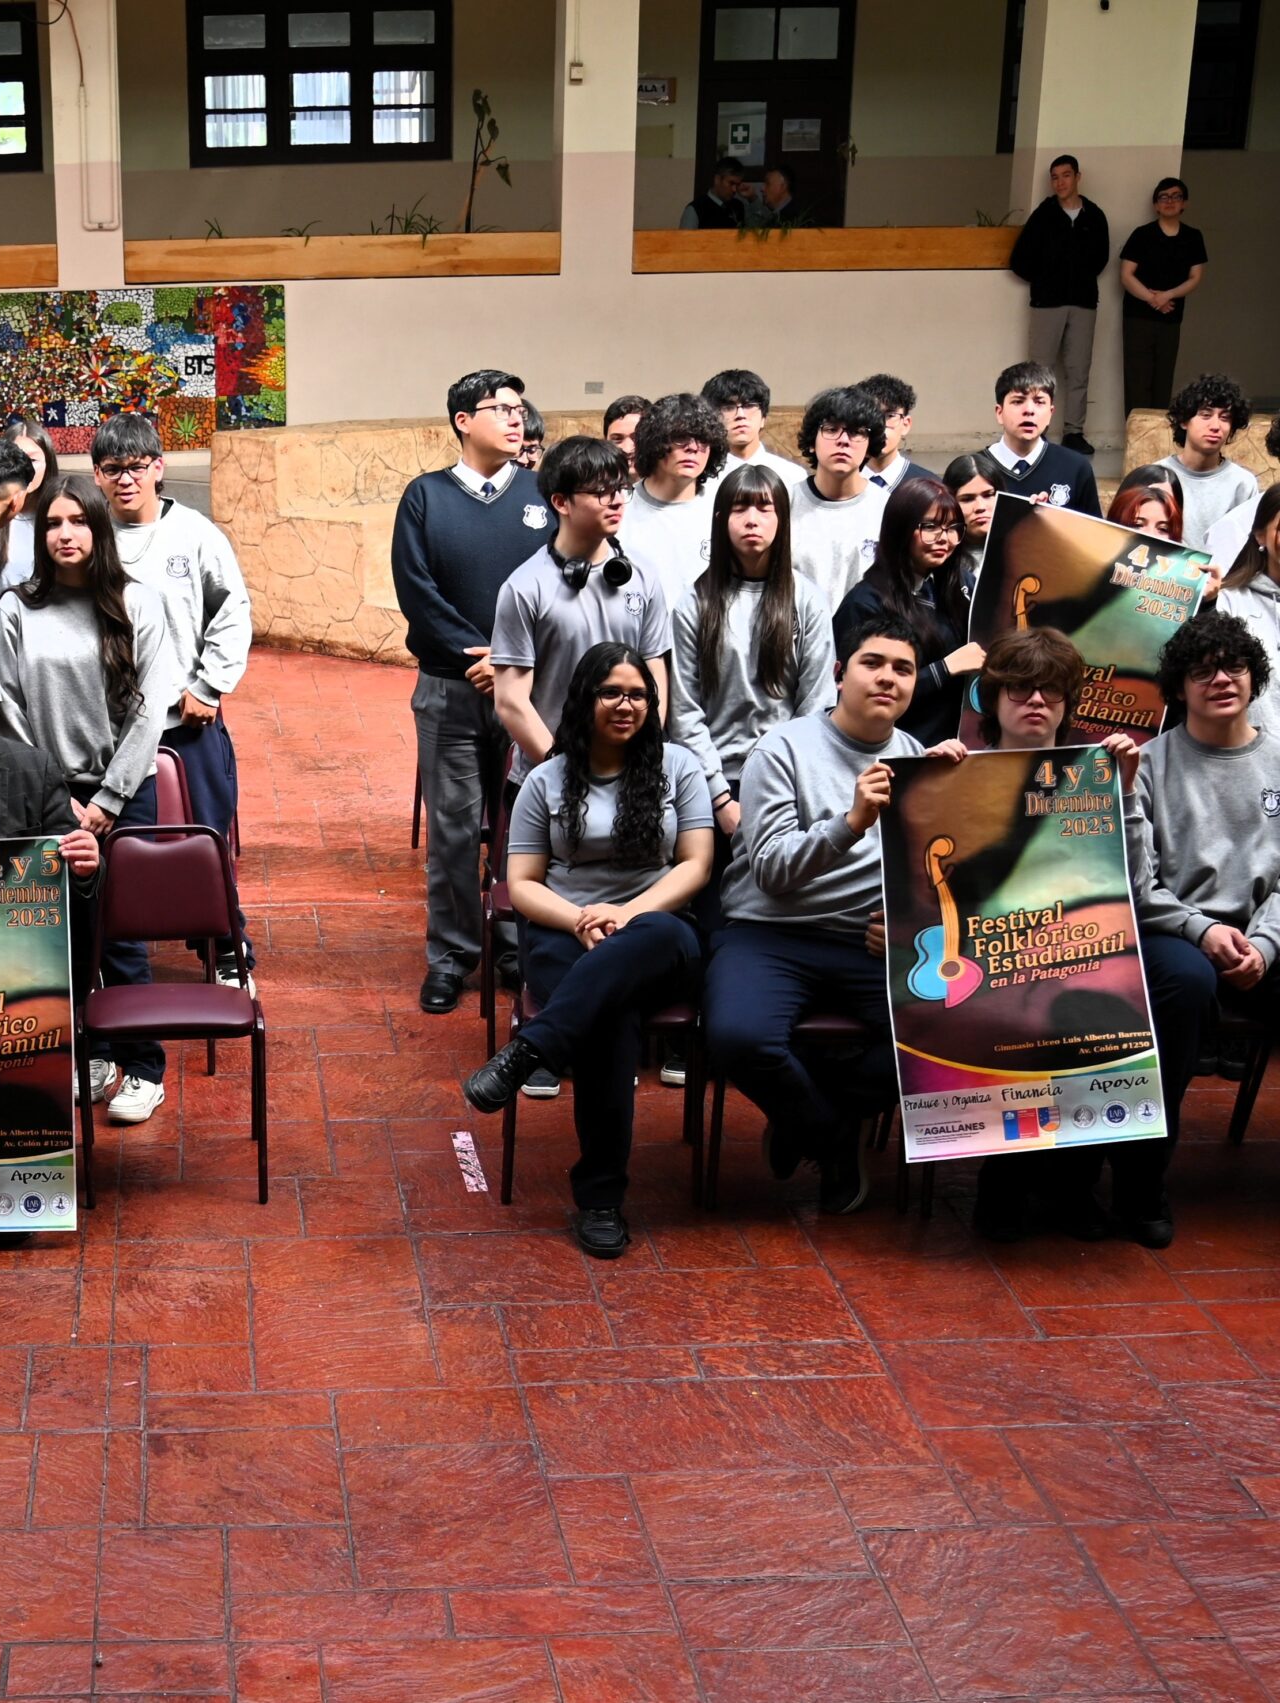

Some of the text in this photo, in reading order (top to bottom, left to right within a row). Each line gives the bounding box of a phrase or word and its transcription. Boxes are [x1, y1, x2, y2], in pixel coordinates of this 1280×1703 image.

[638, 84, 658, 92] ALA
[185, 355, 215, 375] BTS
[1128, 544, 1201, 579] 4 y 5
[1110, 562, 1194, 604] Diciembre
[1135, 596, 1187, 623] 2025
[1082, 682, 1135, 706] órico
[1035, 758, 1112, 792] 4 y 5
[1024, 788, 1113, 816] Diciembre
[1060, 815, 1115, 836] 2025
[10, 856, 32, 883] y
[41, 850, 60, 876] 5
[6, 907, 62, 928] 2025
[967, 901, 1063, 937] Festival
[974, 923, 1098, 958] Folklórico
[990, 960, 1100, 988] en la Patagonia
[994, 1030, 1152, 1052] Gimnasio Liceo Luis Alberto Barrera
[1002, 1084, 1062, 1102] Financia
[1089, 1076, 1149, 1093] Apoya
[904, 1092, 992, 1111] Produce y Organiza
[10, 1170, 64, 1184] Apoya
